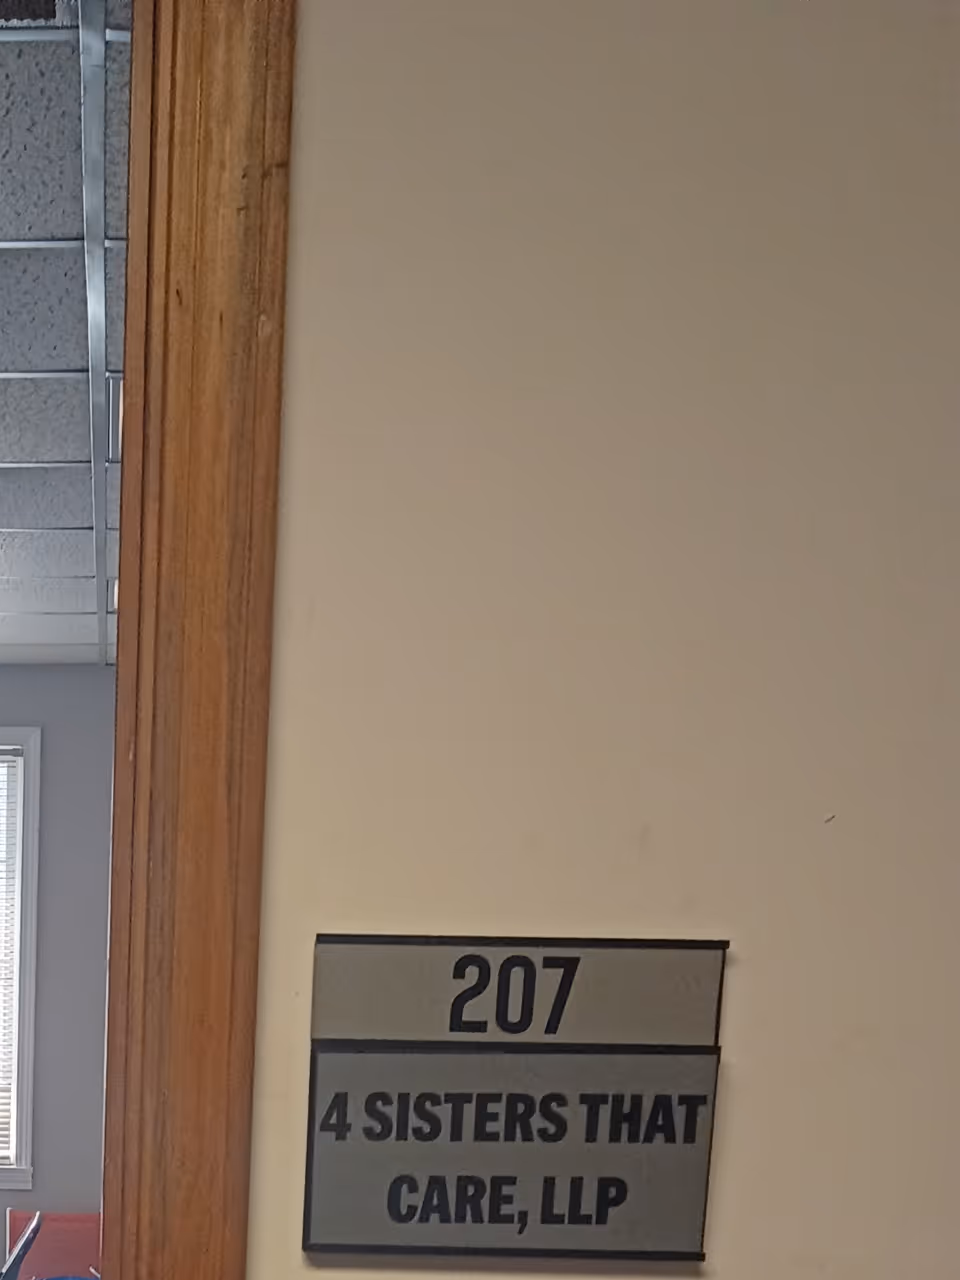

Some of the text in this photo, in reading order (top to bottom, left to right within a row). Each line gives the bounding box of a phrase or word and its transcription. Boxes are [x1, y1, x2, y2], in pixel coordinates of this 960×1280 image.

[449, 954, 581, 1034] 207
[319, 1091, 707, 1144] 4 SISTERS THAT
[386, 1174, 628, 1235] CARE, LLP
